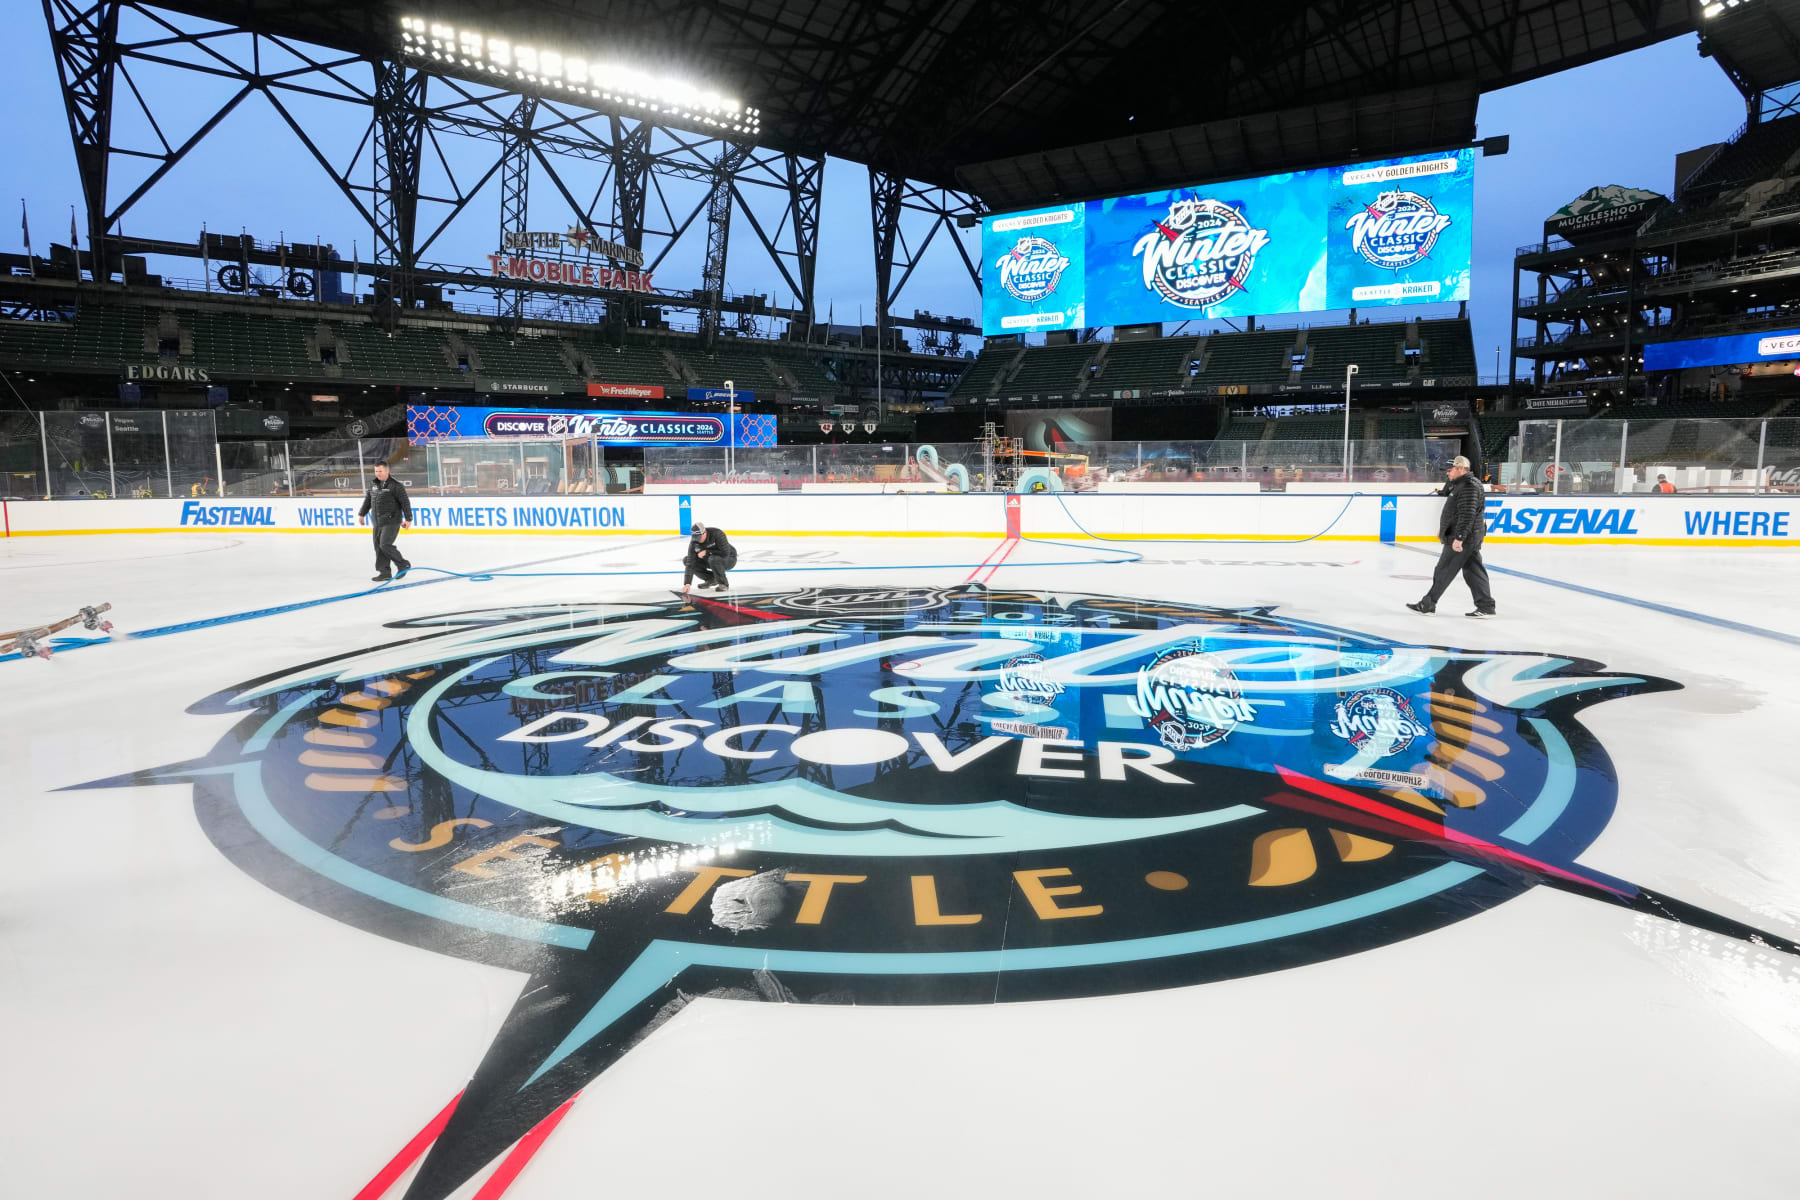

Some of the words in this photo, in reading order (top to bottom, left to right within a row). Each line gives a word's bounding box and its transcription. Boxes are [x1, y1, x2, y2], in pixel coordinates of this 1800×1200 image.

[1385, 166, 1414, 177] GOLDEN
[1416, 162, 1449, 173] KNIGHTS
[1022, 216, 1043, 226] GOLDEN
[1044, 213, 1068, 223] KNIGHTS
[1197, 218, 1221, 229] 2024
[1558, 202, 1645, 229] MUCKLESHOOT
[1345, 207, 1452, 254] Winter
[504, 231, 560, 250] SEATTLE
[590, 237, 644, 267] MARINERS
[1370, 234, 1424, 247] CLASSIC
[1378, 244, 1416, 254] DISCOVER
[1132, 220, 1271, 291] Winter
[1381, 259, 1411, 267] SEATTLE
[487, 254, 595, 287] T-MOBILE
[600, 267, 655, 293] PARK
[995, 251, 1071, 289] Winter
[1013, 272, 1052, 283] CLASSIC
[1165, 257, 1237, 280] CLASSIC
[1176, 272, 1227, 290] DISCOVER
[1402, 284, 1433, 294] KRAKEN
[1184, 294, 1221, 306] SEATTLE
[502, 383, 549, 392] STARBUCKS
[113, 417, 135, 425] Vegas
[496, 421, 545, 432] DISCOVER
[568, 415, 639, 437] Wnter
[640, 423, 695, 435] CLASSIC
[179, 500, 276, 526] FASTENAL
[298, 507, 355, 527] WHERE
[449, 506, 508, 527] MEETS
[513, 506, 626, 527] INNOVATION
[1484, 500, 1639, 534] FASTENAL
[1684, 511, 1790, 536] WHERE
[811, 590, 920, 606] NHL
[949, 610, 1129, 625] 2024
[224, 604, 1650, 710] Winter
[501, 670, 1314, 738] CLASSIC
[496, 709, 1195, 785] DISCOVER
